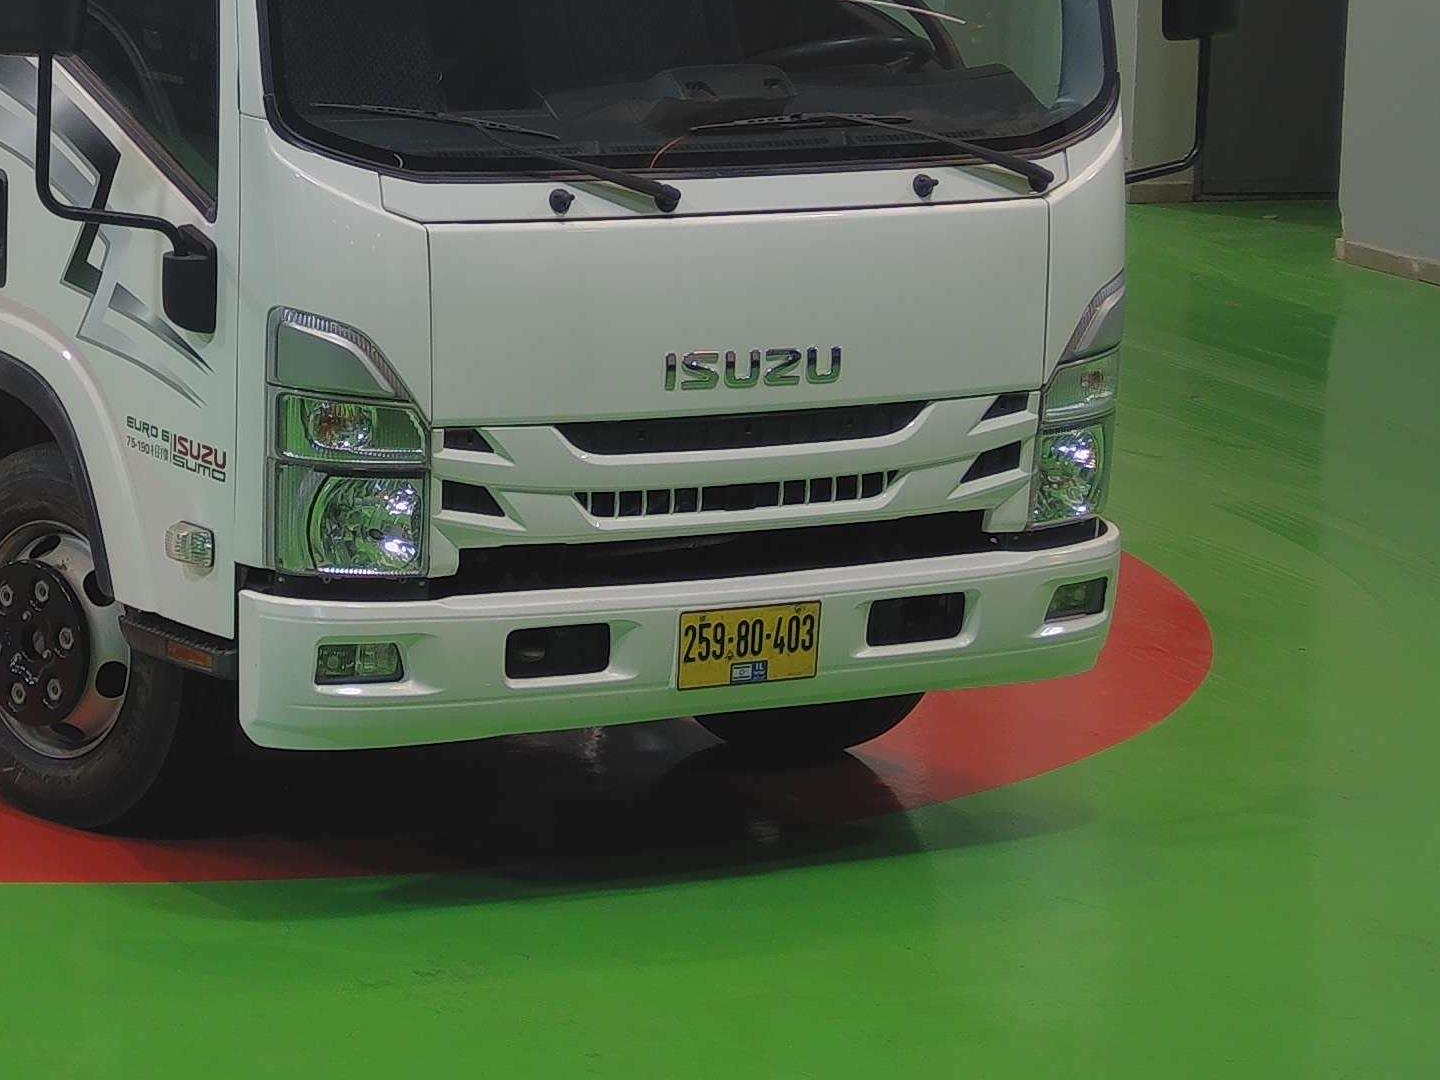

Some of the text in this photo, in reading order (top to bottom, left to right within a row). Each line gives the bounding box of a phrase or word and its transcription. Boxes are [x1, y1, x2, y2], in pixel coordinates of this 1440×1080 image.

[665, 346, 841, 391] ISUZU
[126, 415, 159, 439] EURO
[172, 453, 226, 483] SUMO
[173, 433, 227, 470] ISUZU
[683, 614, 816, 663] 259-80-403
